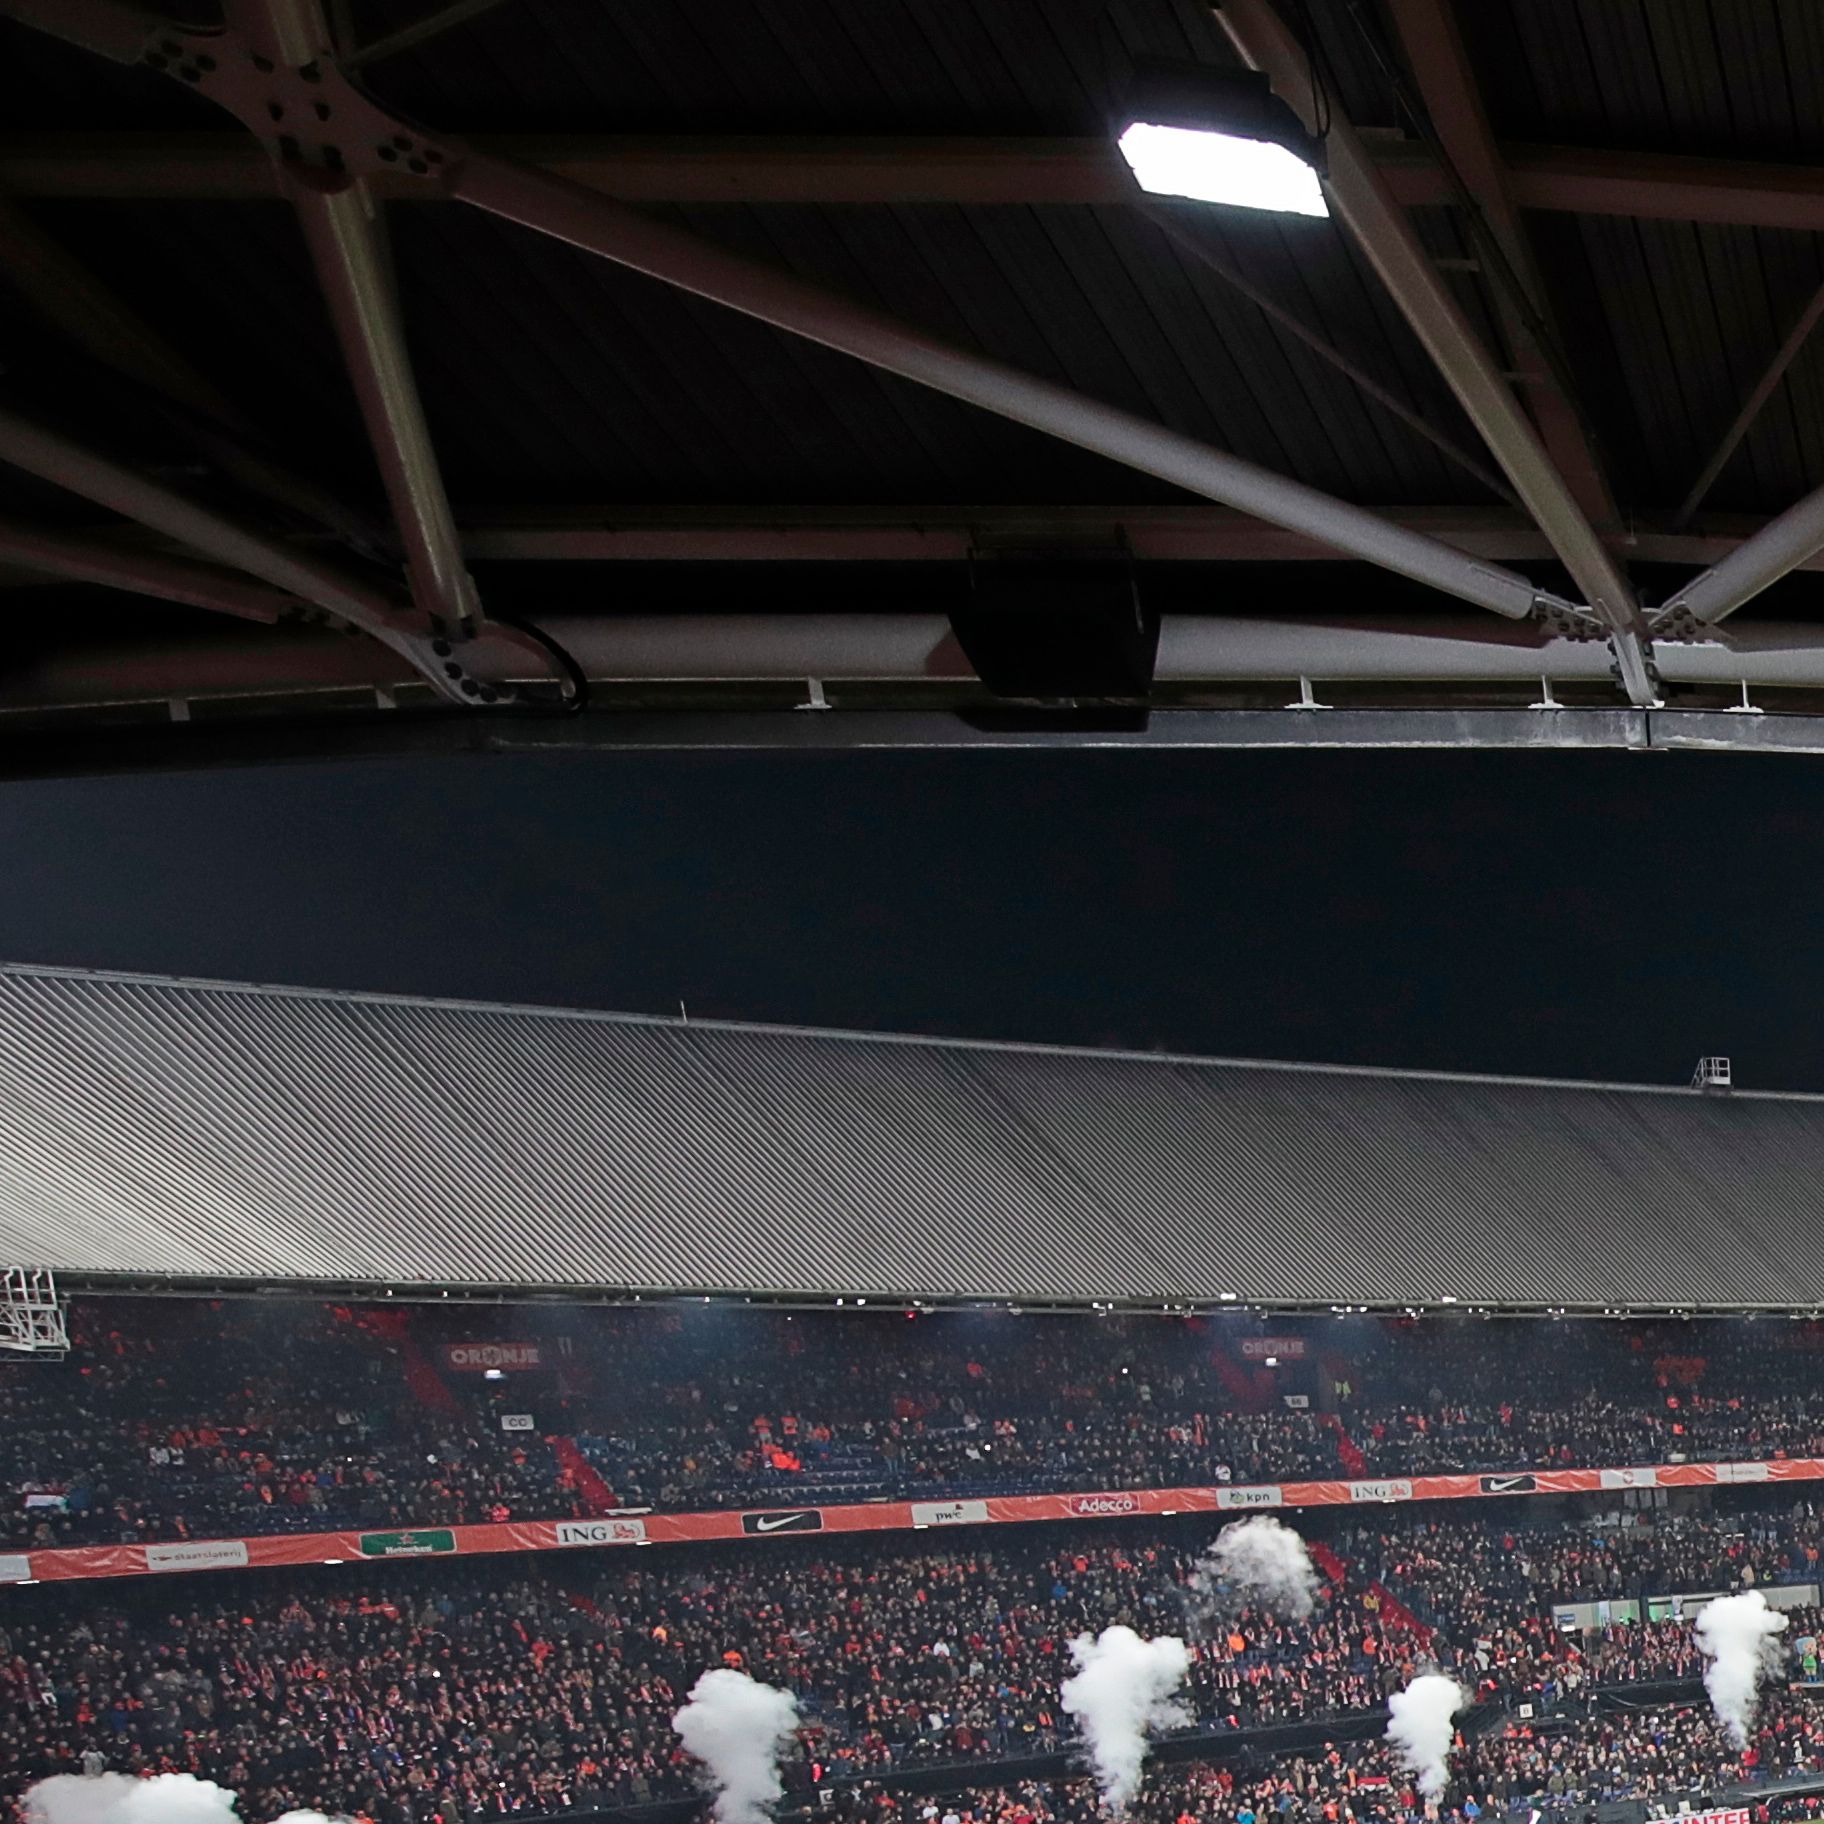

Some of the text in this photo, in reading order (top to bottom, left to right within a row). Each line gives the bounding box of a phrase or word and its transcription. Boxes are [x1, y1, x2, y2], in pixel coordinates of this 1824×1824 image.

[509, 1417, 528, 1428] CC
[1247, 1493, 1270, 1504] kpn
[1355, 1484, 1387, 1499] ING
[1080, 1496, 1132, 1513] Adecco
[562, 1525, 608, 1544] ING
